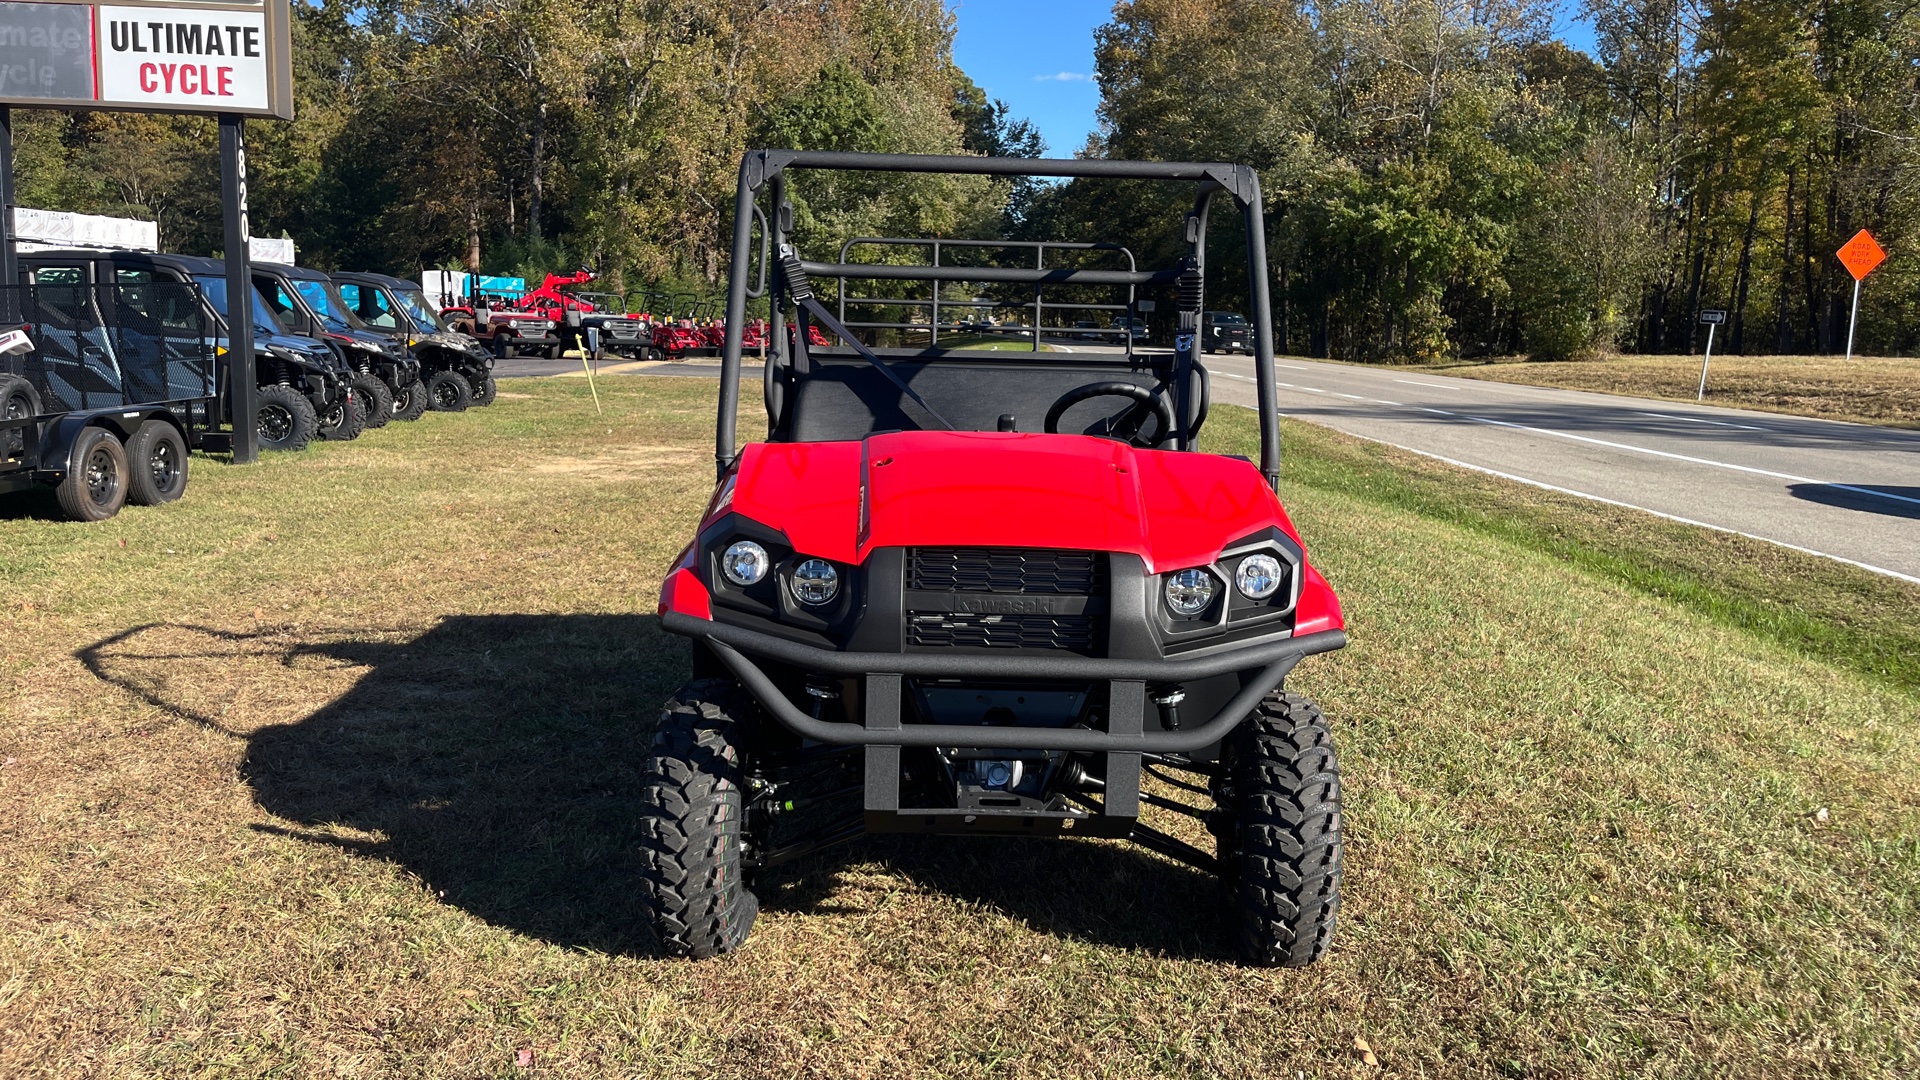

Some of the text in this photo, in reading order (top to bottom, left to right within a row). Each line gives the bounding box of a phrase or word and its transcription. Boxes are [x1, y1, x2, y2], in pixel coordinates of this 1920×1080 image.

[110, 20, 260, 58] ULTIMATE
[140, 62, 235, 97] CYCLE
[1852, 242, 1871, 250] ROAD
[1851, 250, 1871, 258] WORK
[1848, 258, 1872, 266] AHEAD
